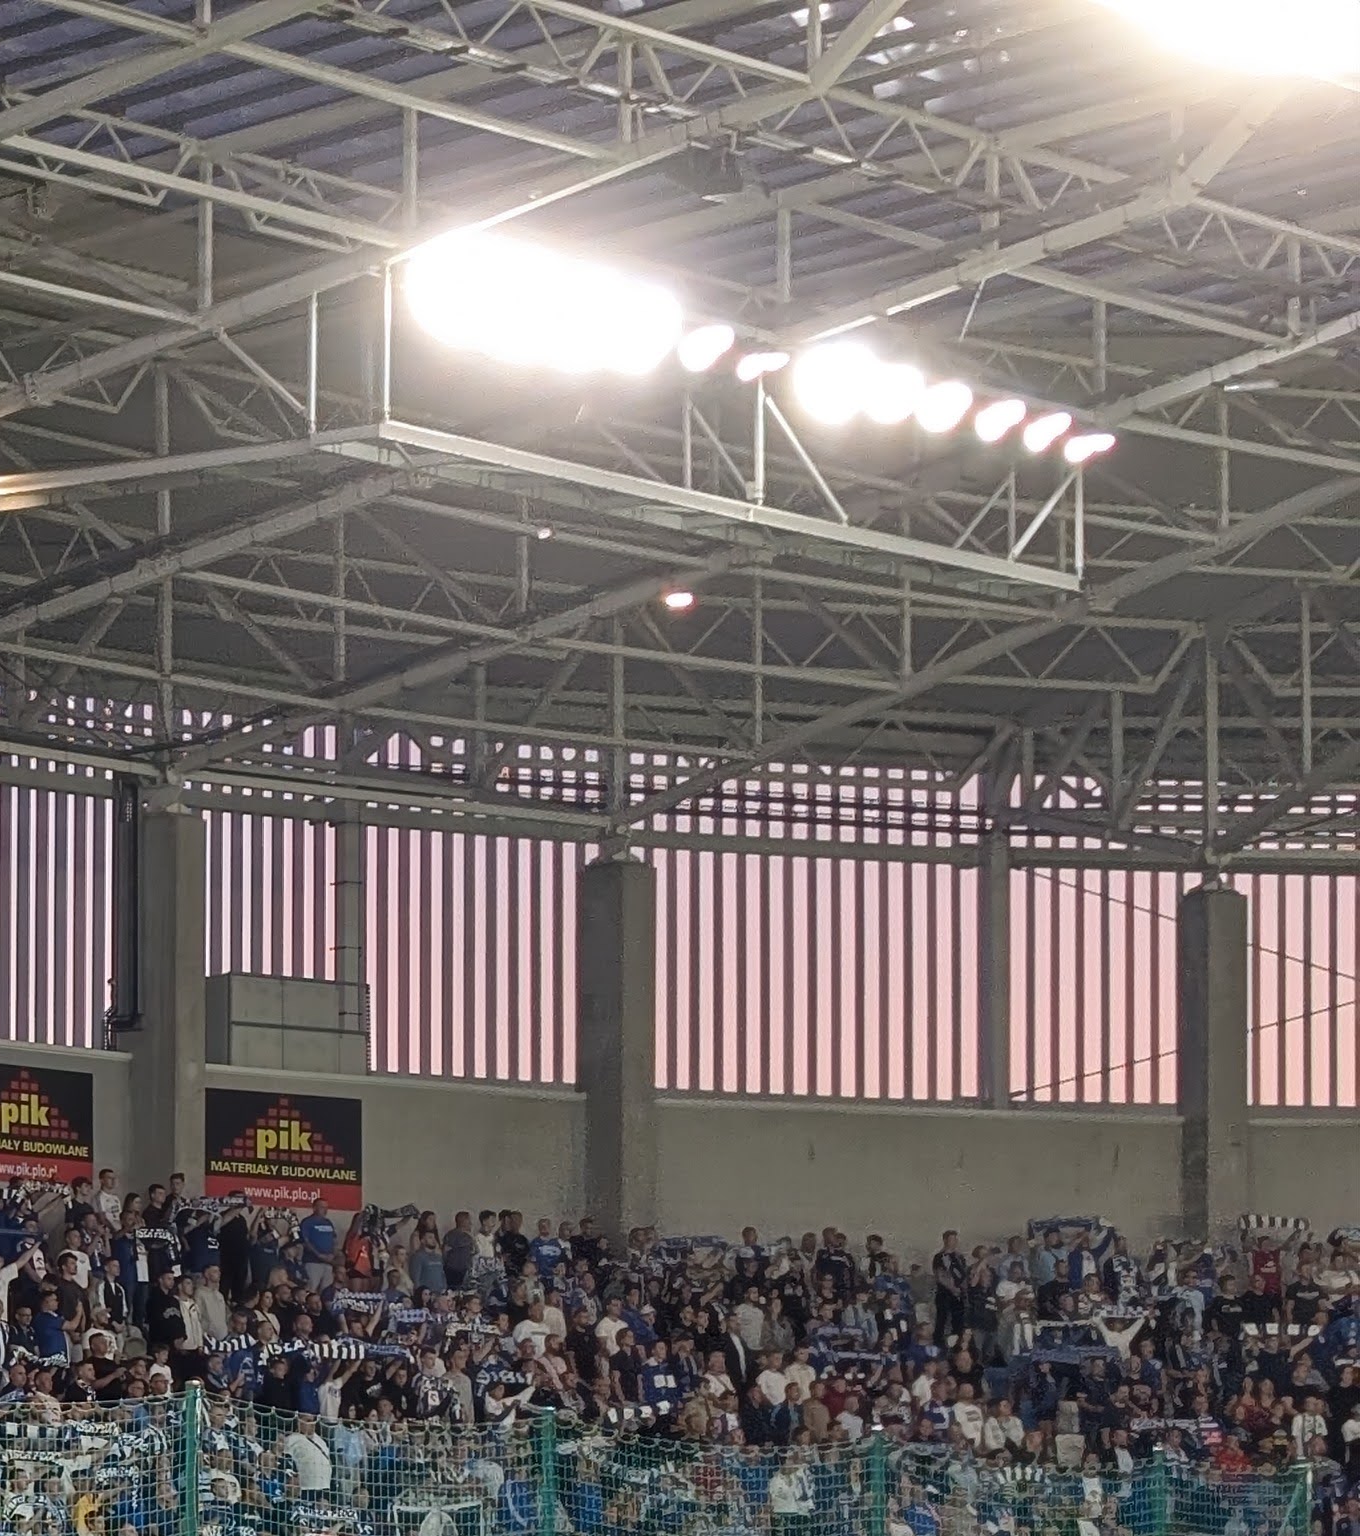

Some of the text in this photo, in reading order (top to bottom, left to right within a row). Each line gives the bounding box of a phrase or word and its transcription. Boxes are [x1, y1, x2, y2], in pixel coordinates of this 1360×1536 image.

[0, 1093, 50, 1133] pik
[23, 1142, 89, 1158] BUDOWLANE
[256, 1119, 313, 1159] pik
[210, 1161, 357, 1181] MATERIAŁY BUDOWLANE
